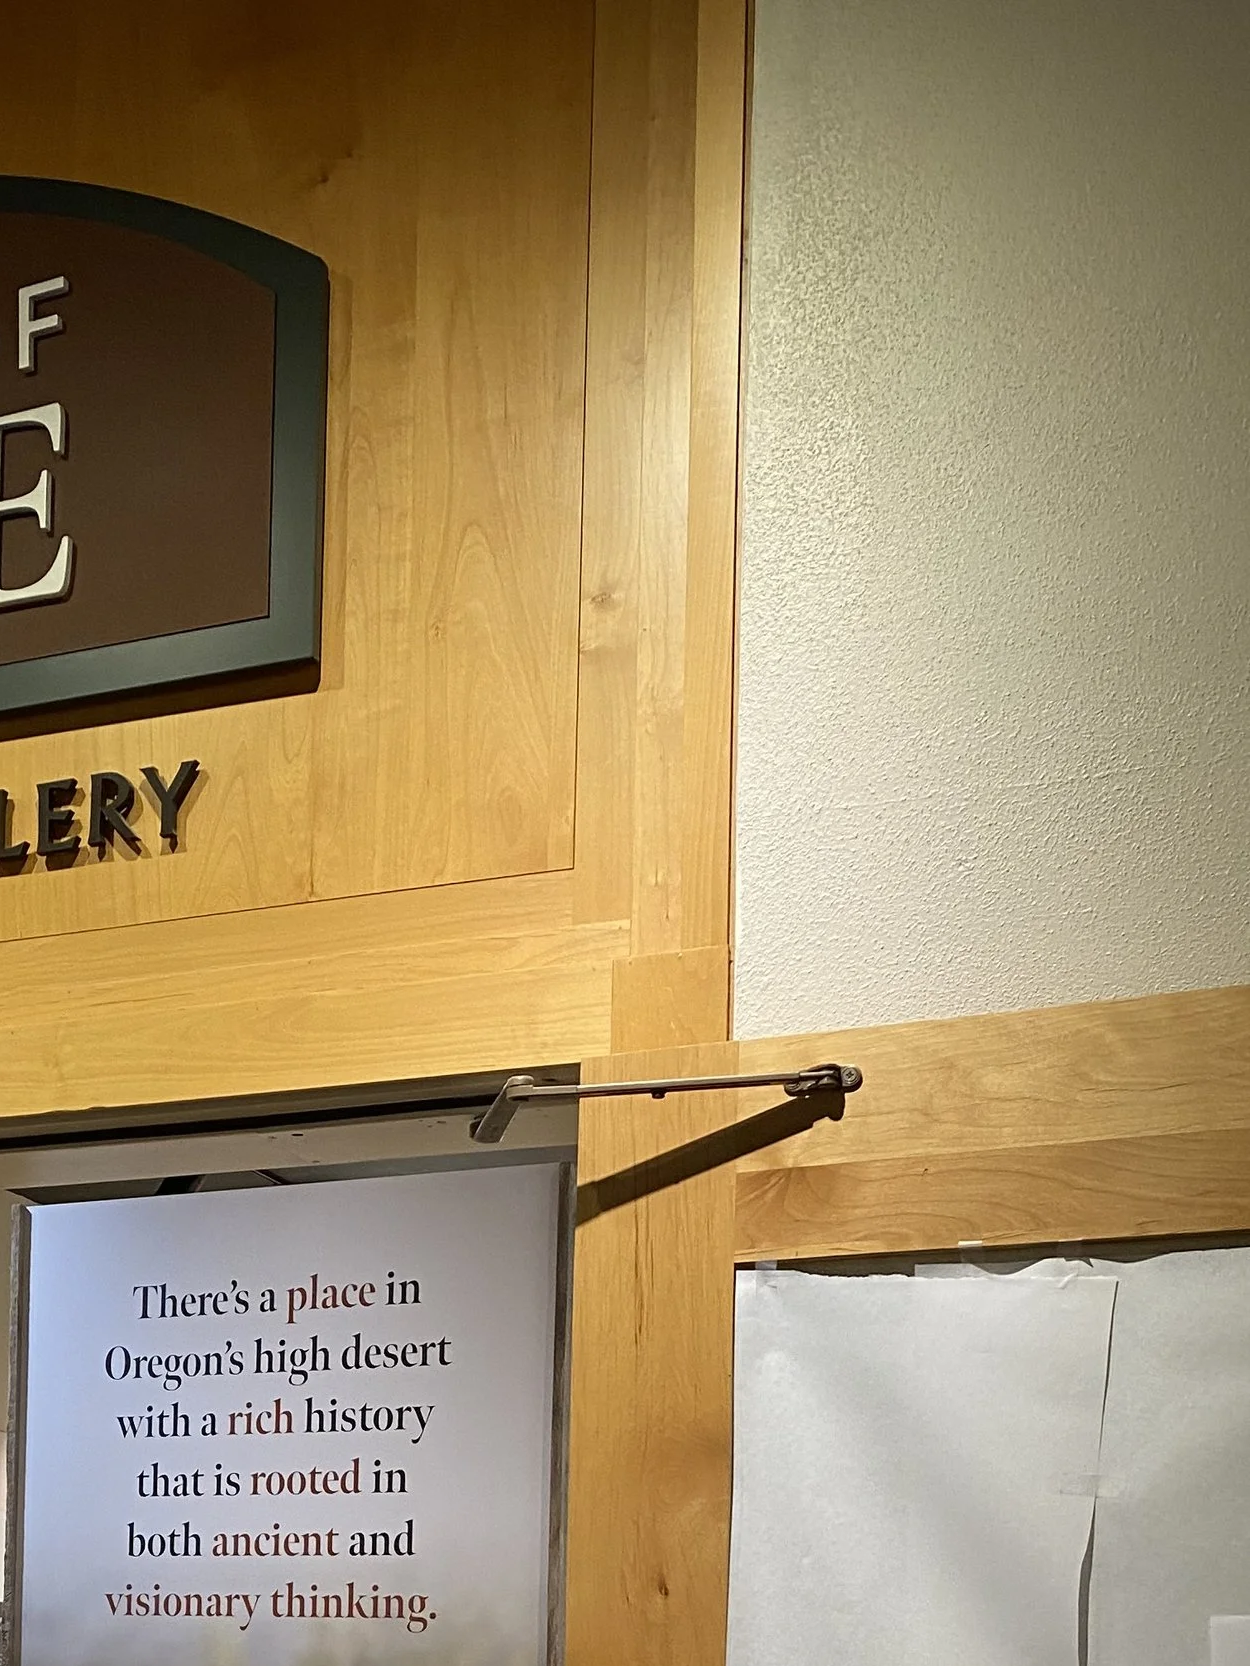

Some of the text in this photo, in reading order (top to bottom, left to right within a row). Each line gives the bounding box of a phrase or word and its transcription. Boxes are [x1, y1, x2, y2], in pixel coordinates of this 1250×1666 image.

[133, 1271, 421, 1324] There’s a place in
[104, 1333, 452, 1391] Oregon’s high desert
[117, 1397, 436, 1444] with a rich history
[137, 1458, 408, 1497] that is rooted in
[128, 1519, 416, 1557] both ancient and
[105, 1582, 438, 1634] visionary thinking.
